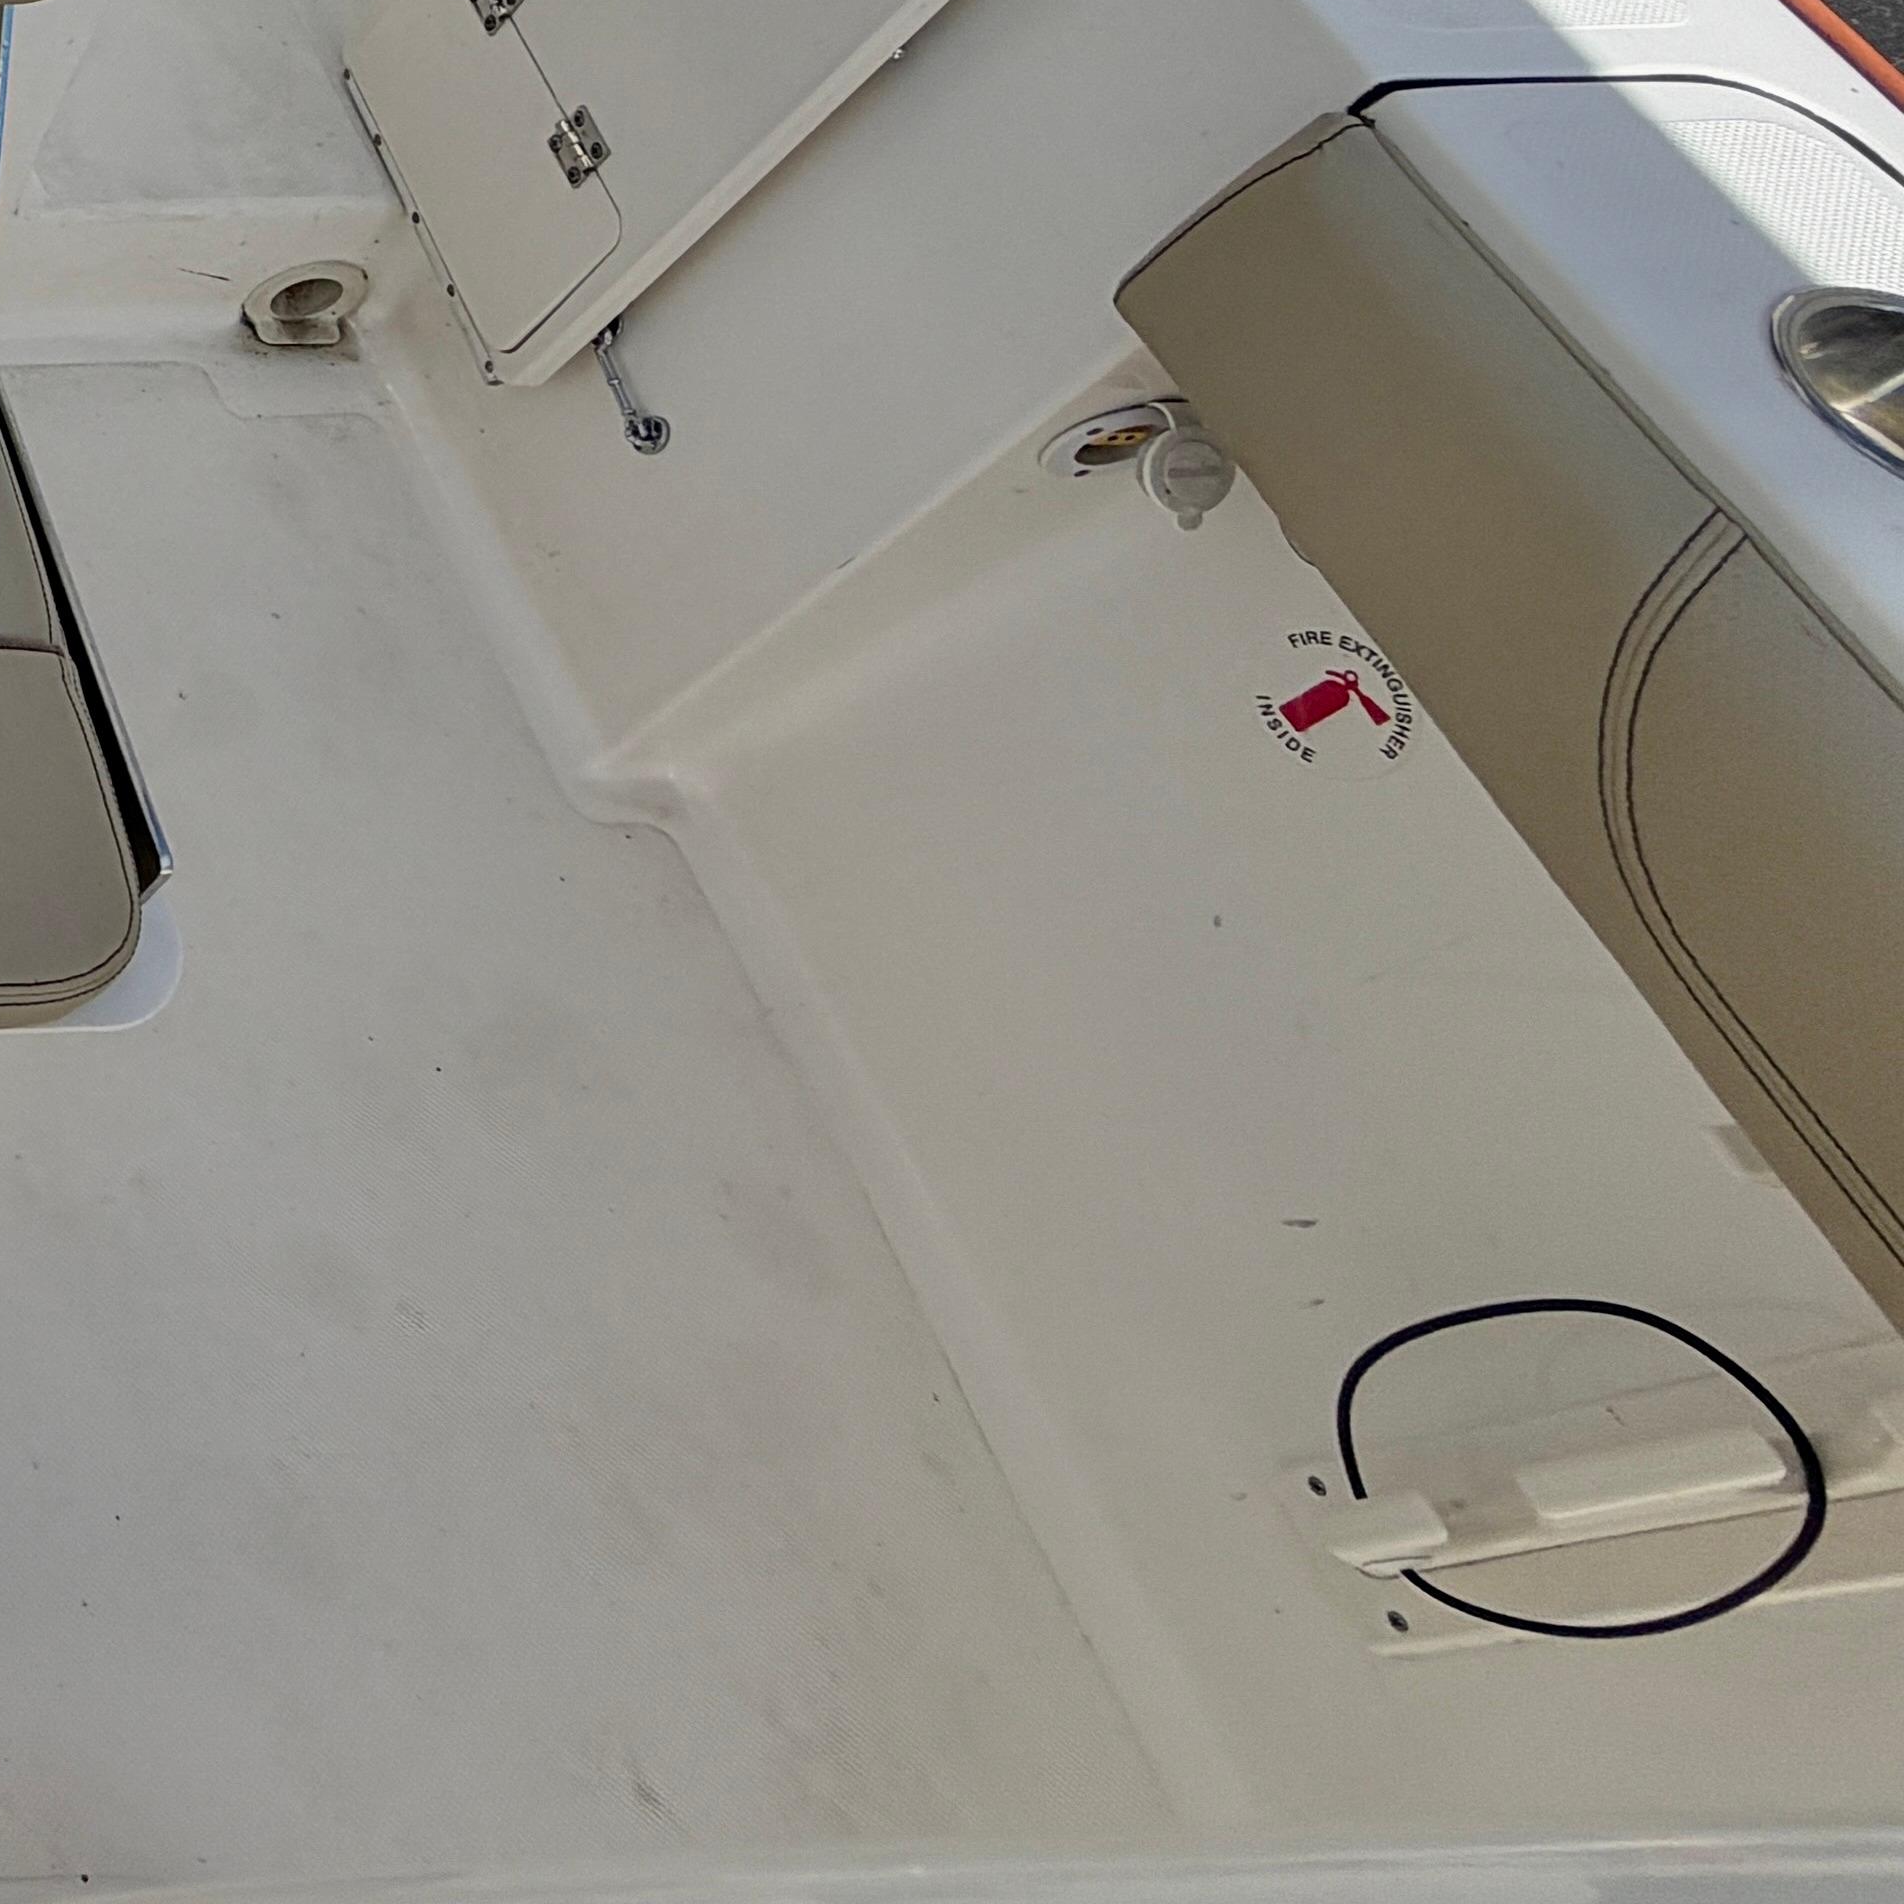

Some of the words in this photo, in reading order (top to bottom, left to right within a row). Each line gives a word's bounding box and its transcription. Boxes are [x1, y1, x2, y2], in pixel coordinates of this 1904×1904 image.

[1255, 695, 1317, 763] INSIDE
[1287, 630, 1333, 648] FIRE
[1338, 635, 1412, 760] EXTINGUISHER
